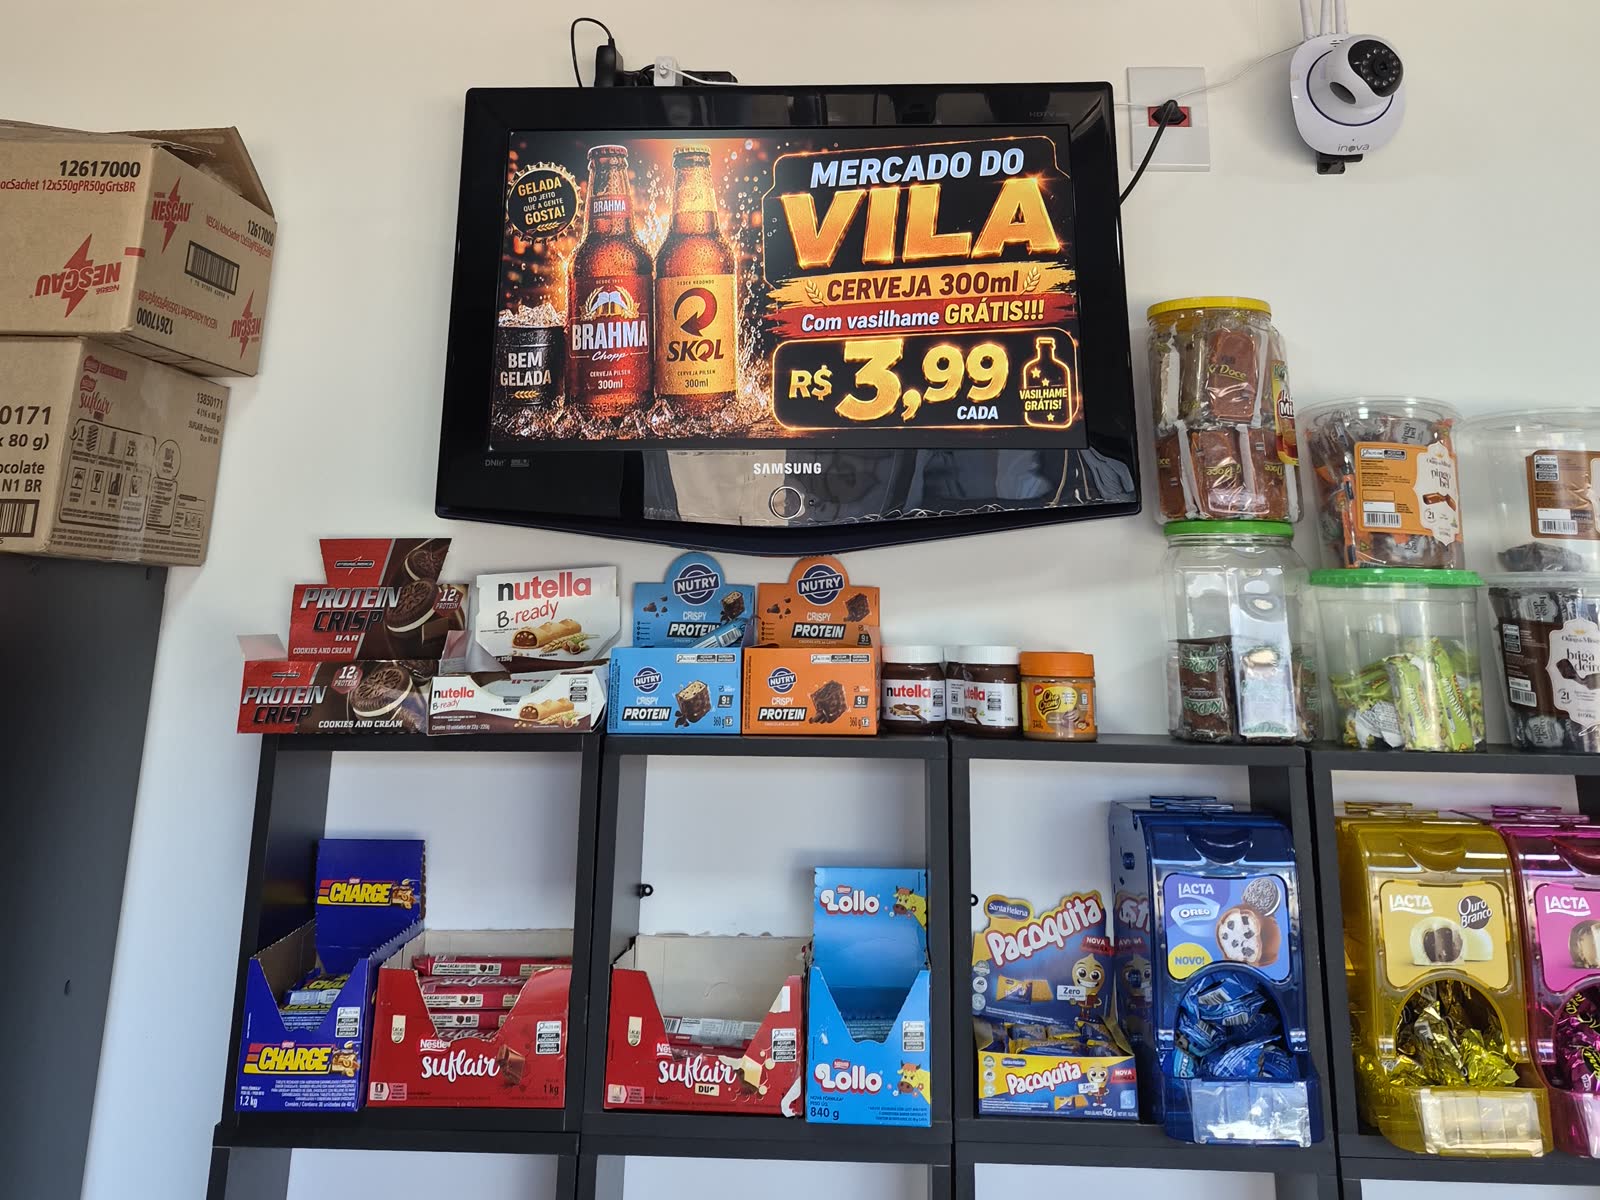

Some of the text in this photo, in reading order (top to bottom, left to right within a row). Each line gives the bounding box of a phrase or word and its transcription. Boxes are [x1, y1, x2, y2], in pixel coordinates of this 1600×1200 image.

[60, 160, 141, 177] 12617000
[810, 147, 1025, 188] MERCADO DO
[518, 176, 562, 196] GELADA
[523, 204, 536, 212] QUE
[543, 198, 564, 207] GENTE
[528, 191, 556, 203] DO JEITO
[151, 200, 190, 221] NESCAU
[593, 199, 626, 213] BRAHMA
[525, 205, 566, 225] GOSTA!
[781, 176, 1062, 270] VILA
[248, 220, 274, 247] 12617000
[35, 262, 122, 296] NESCAU
[826, 270, 1018, 301] CERVEJA 300ml
[137, 307, 174, 335] 12617000
[801, 298, 1045, 332] Com vasilhame GRÁTIS!!!
[231, 318, 262, 338] NESCAU
[572, 320, 648, 351] BRAHMA
[592, 350, 629, 362] Chopp
[666, 339, 724, 363] SKOL
[507, 352, 543, 369] BEM
[500, 370, 551, 387] GELADA
[589, 369, 612, 377] CERVEJA
[788, 336, 1010, 423] R$ 3,99
[598, 379, 624, 389] 300ml
[684, 379, 709, 389] 300ml
[1019, 387, 1068, 400] VASILHAME
[956, 405, 999, 420] CADA
[1024, 398, 1062, 411] GRÁTIS!
[8, 433, 50, 451] 80 g)
[753, 463, 822, 475] SAMSUNG
[2, 479, 42, 492] N1 BR
[498, 571, 592, 602] nutella
[677, 574, 716, 592] NUTRY
[801, 575, 840, 592] NUTRY
[299, 587, 402, 609] PROTEIN
[435, 602, 459, 610] PROTEIN
[312, 609, 385, 632] CRISP
[496, 600, 559, 629] B-ready
[682, 611, 706, 621] CRISPY
[807, 612, 831, 622] CRISPY
[334, 634, 360, 642] BAR
[793, 624, 845, 638] PROTEIN
[293, 647, 352, 655] COOKIES AND CREAM
[333, 679, 358, 687] PROTEIN
[636, 674, 660, 685] NUTRY
[770, 675, 795, 686] NUTRY
[241, 686, 327, 705] PROTEIN
[434, 687, 475, 699] nutella
[886, 684, 931, 698] nutella
[432, 699, 460, 711] B-ready
[636, 696, 659, 705] CRISPY
[771, 697, 794, 705] CRISPY
[252, 706, 314, 724] CRISP
[623, 708, 670, 720] PROTEIN
[759, 708, 806, 720] PROTEIN
[318, 719, 403, 729] COOKIES AND CREAM
[329, 882, 393, 903] CHARGE
[1178, 882, 1214, 899] LACTA
[820, 888, 881, 915] Lollo
[1389, 895, 1433, 914] LACTA
[1458, 898, 1487, 917] Ouro
[1544, 896, 1592, 917] LACTA
[1180, 907, 1210, 919] OREO
[1460, 908, 1493, 928] Branco
[987, 898, 1102, 966] Paçoquita
[1086, 936, 1105, 945] NOVA
[1174, 955, 1205, 965] NOVO!
[1063, 987, 1081, 995] Zero
[258, 1047, 332, 1072] CHARGE
[421, 1050, 500, 1082] suflair
[658, 1054, 737, 1088] suflair
[814, 1063, 883, 1094] Lollo
[1006, 1062, 1082, 1096] Paçoquita
[543, 1085, 559, 1095] 1 kg
[250, 1096, 258, 1108] kg
[810, 1107, 840, 1120] 840 g
